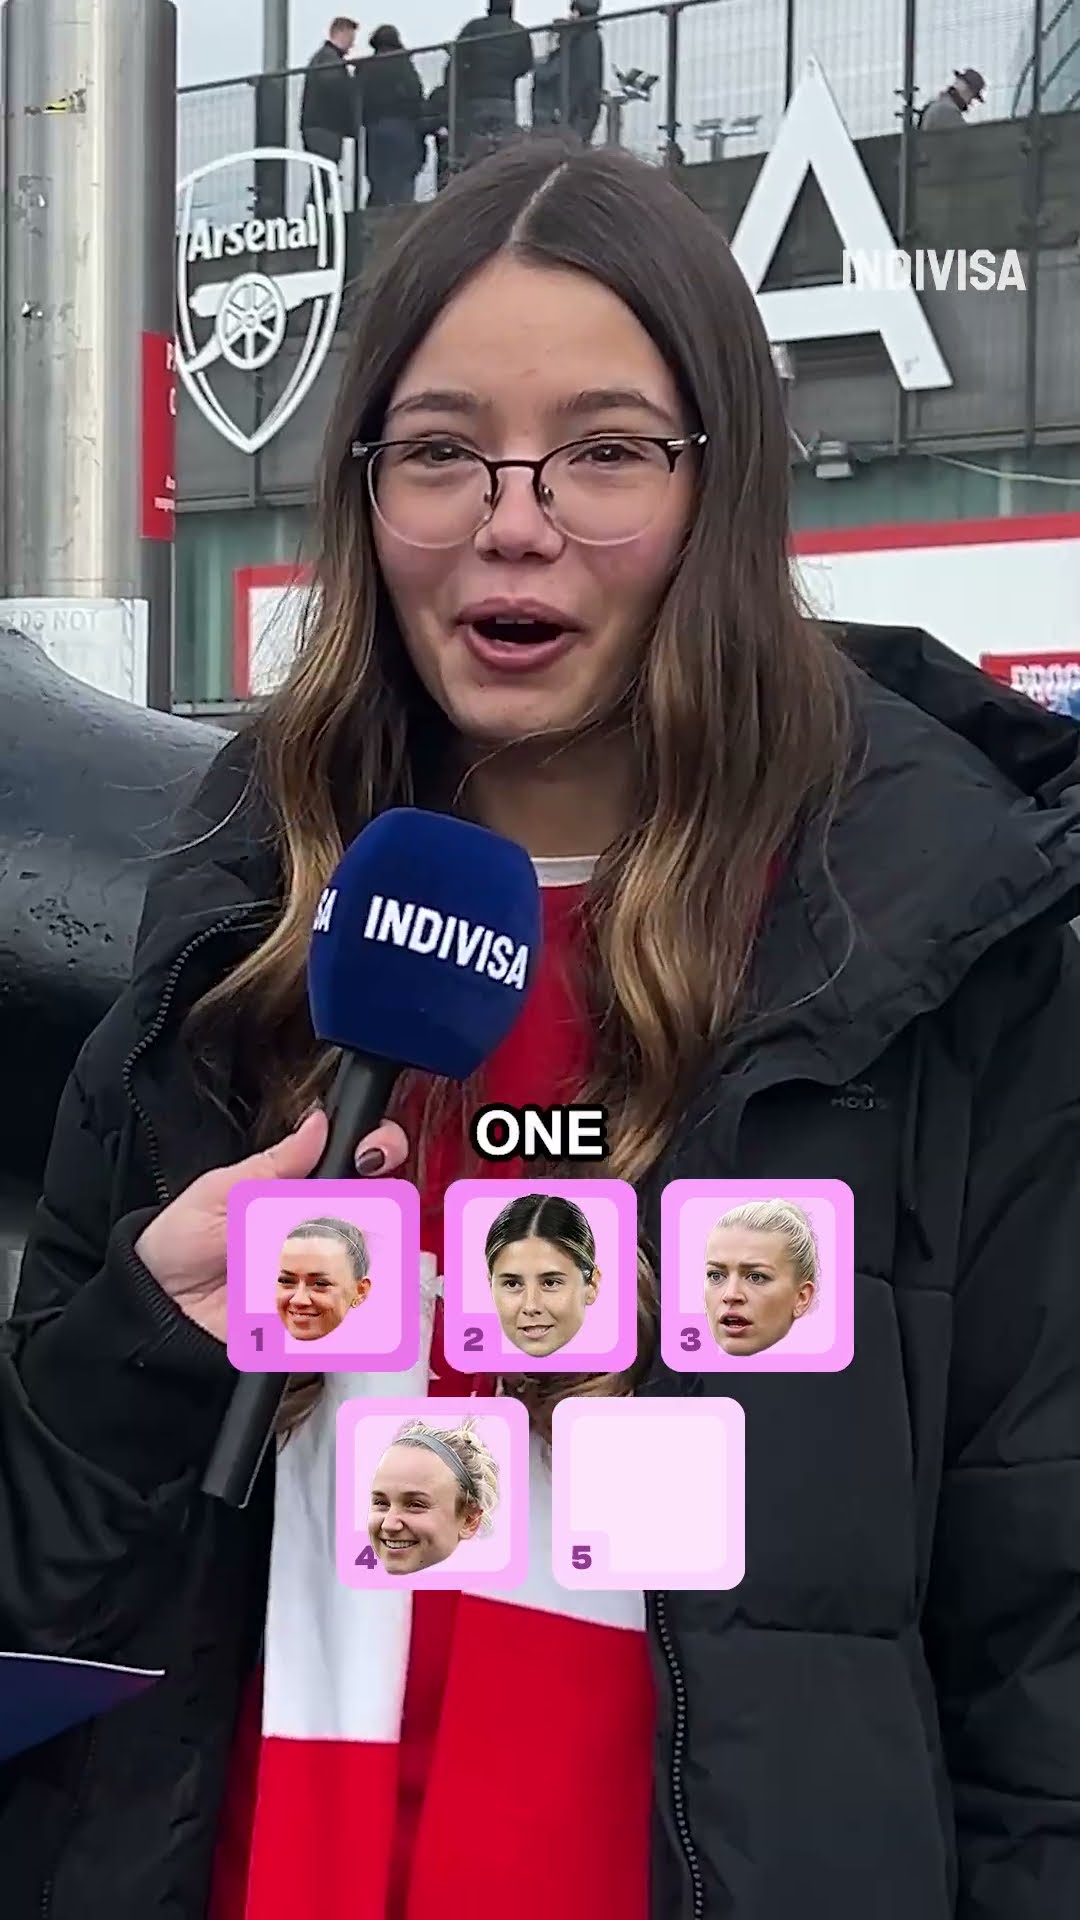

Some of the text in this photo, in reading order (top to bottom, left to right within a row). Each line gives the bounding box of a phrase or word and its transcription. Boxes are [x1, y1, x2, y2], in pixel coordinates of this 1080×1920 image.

[187, 203, 318, 262] Arsenal
[53, 608, 98, 632] NOT
[363, 895, 529, 990] INDIVISA
